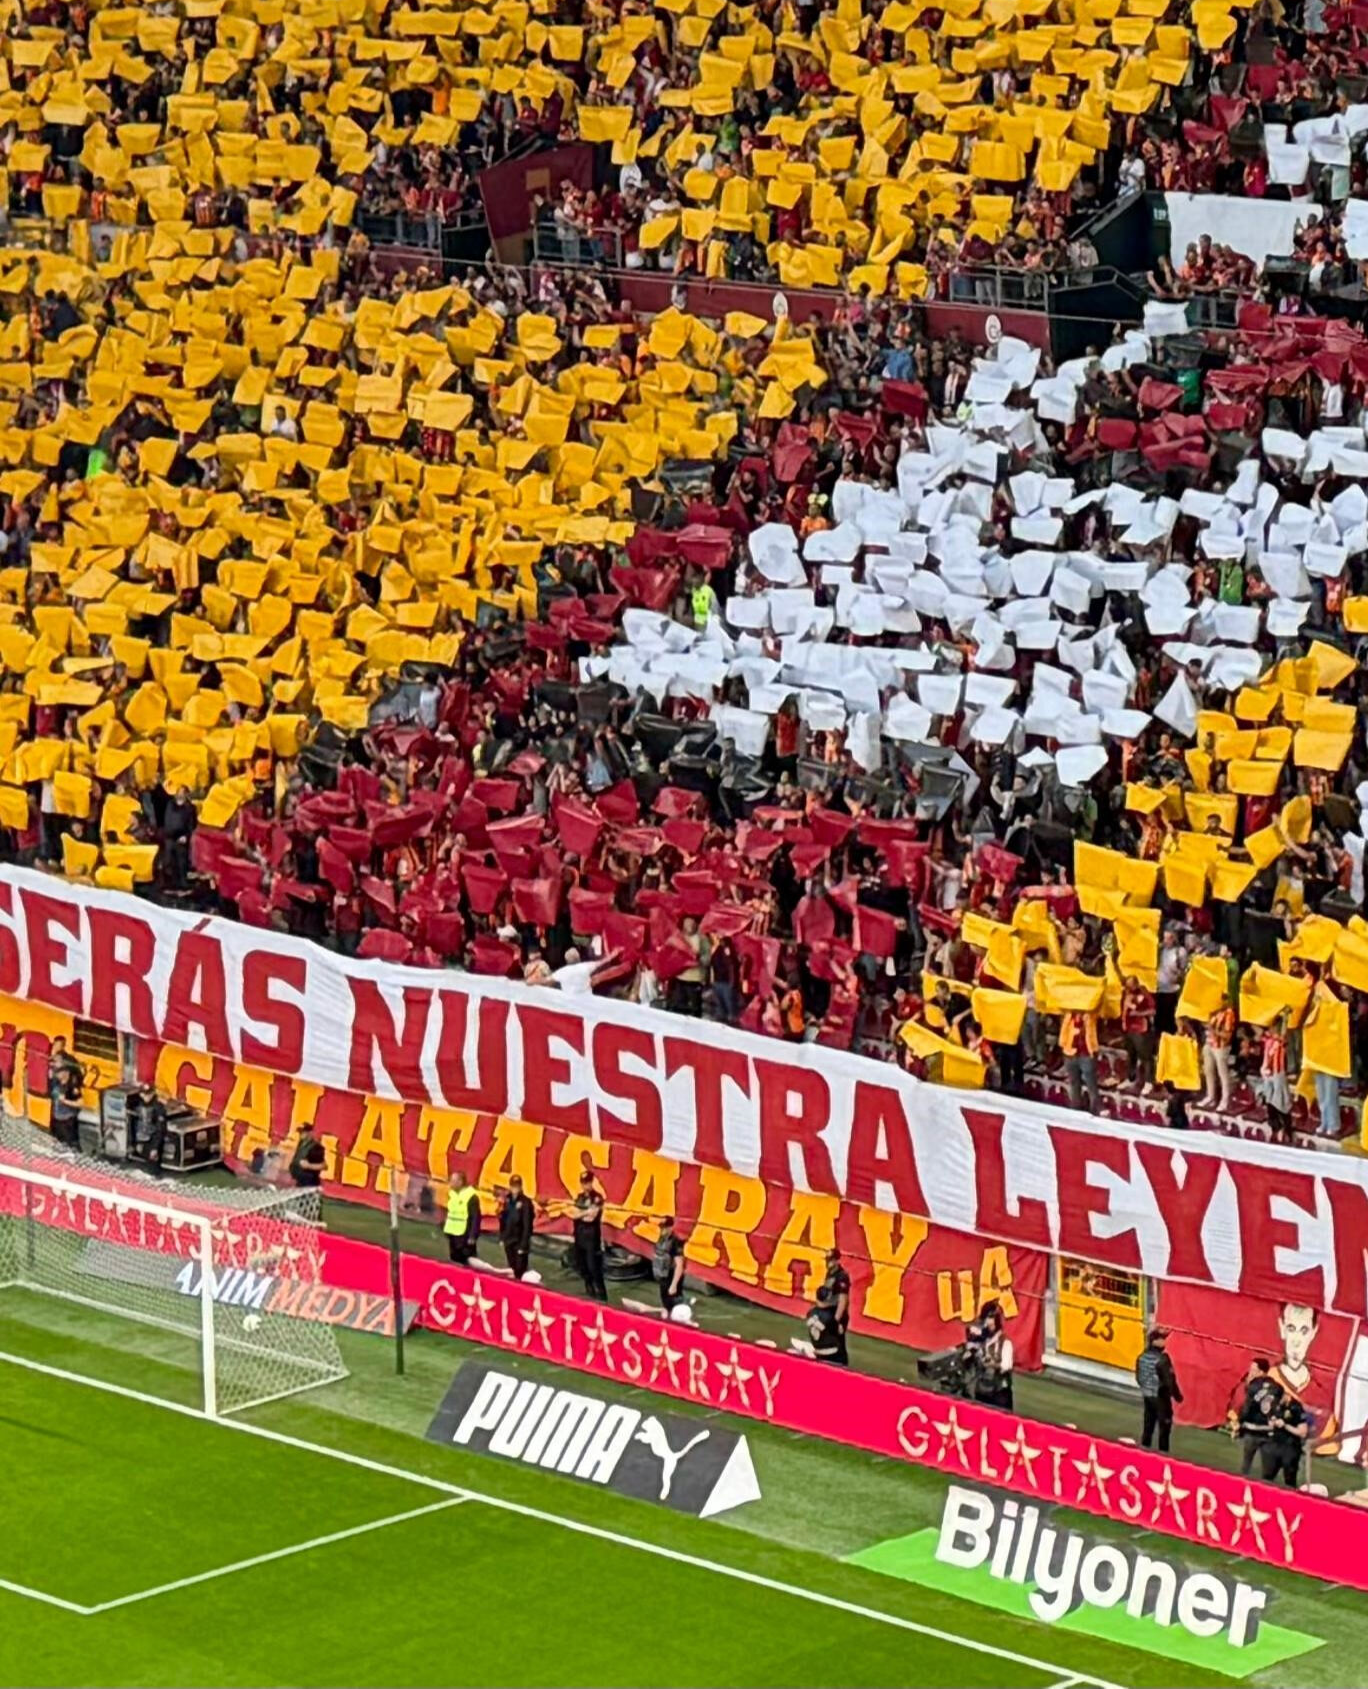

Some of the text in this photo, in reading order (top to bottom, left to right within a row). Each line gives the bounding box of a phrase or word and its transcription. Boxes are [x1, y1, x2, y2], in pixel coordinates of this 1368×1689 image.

[347, 978, 930, 1218] NUESTRA
[22, 1172, 327, 1282] GALATAARAY
[155, 1043, 928, 1326] GALATASARAY
[265, 1276, 397, 1336] MEDYA
[427, 1278, 783, 1414] GALATASARAY
[1084, 1307, 1115, 1342] 23
[453, 1370, 643, 1484] PUMA
[896, 1404, 1302, 1564] GALATASARAY
[935, 1484, 1267, 1647] Bilyoner
